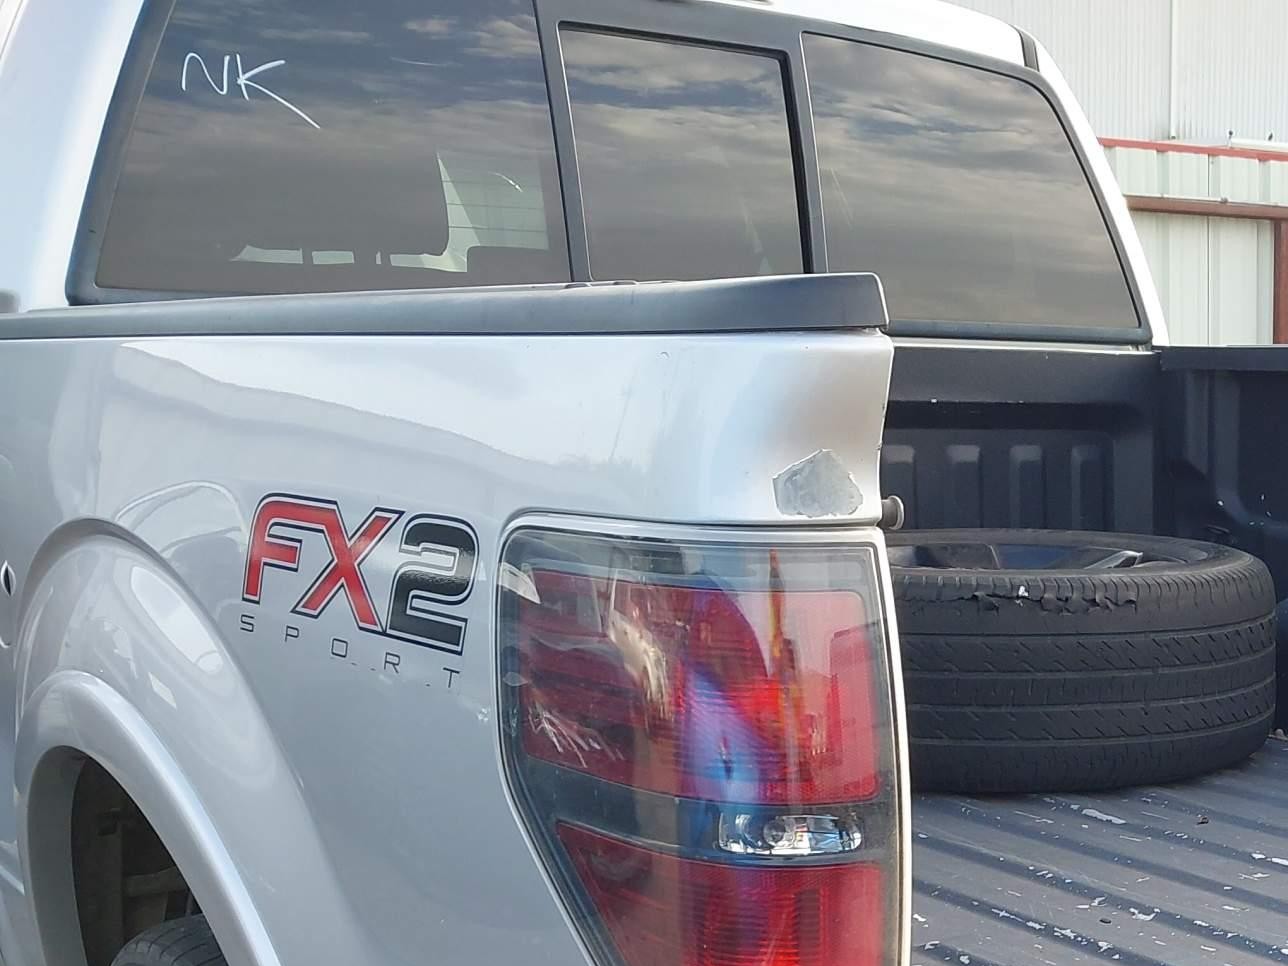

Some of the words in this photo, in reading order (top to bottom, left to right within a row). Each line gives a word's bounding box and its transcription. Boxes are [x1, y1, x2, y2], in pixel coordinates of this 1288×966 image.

[181, 52, 320, 129] NK
[241, 492, 480, 657] FX2
[239, 613, 461, 689] SPORT
